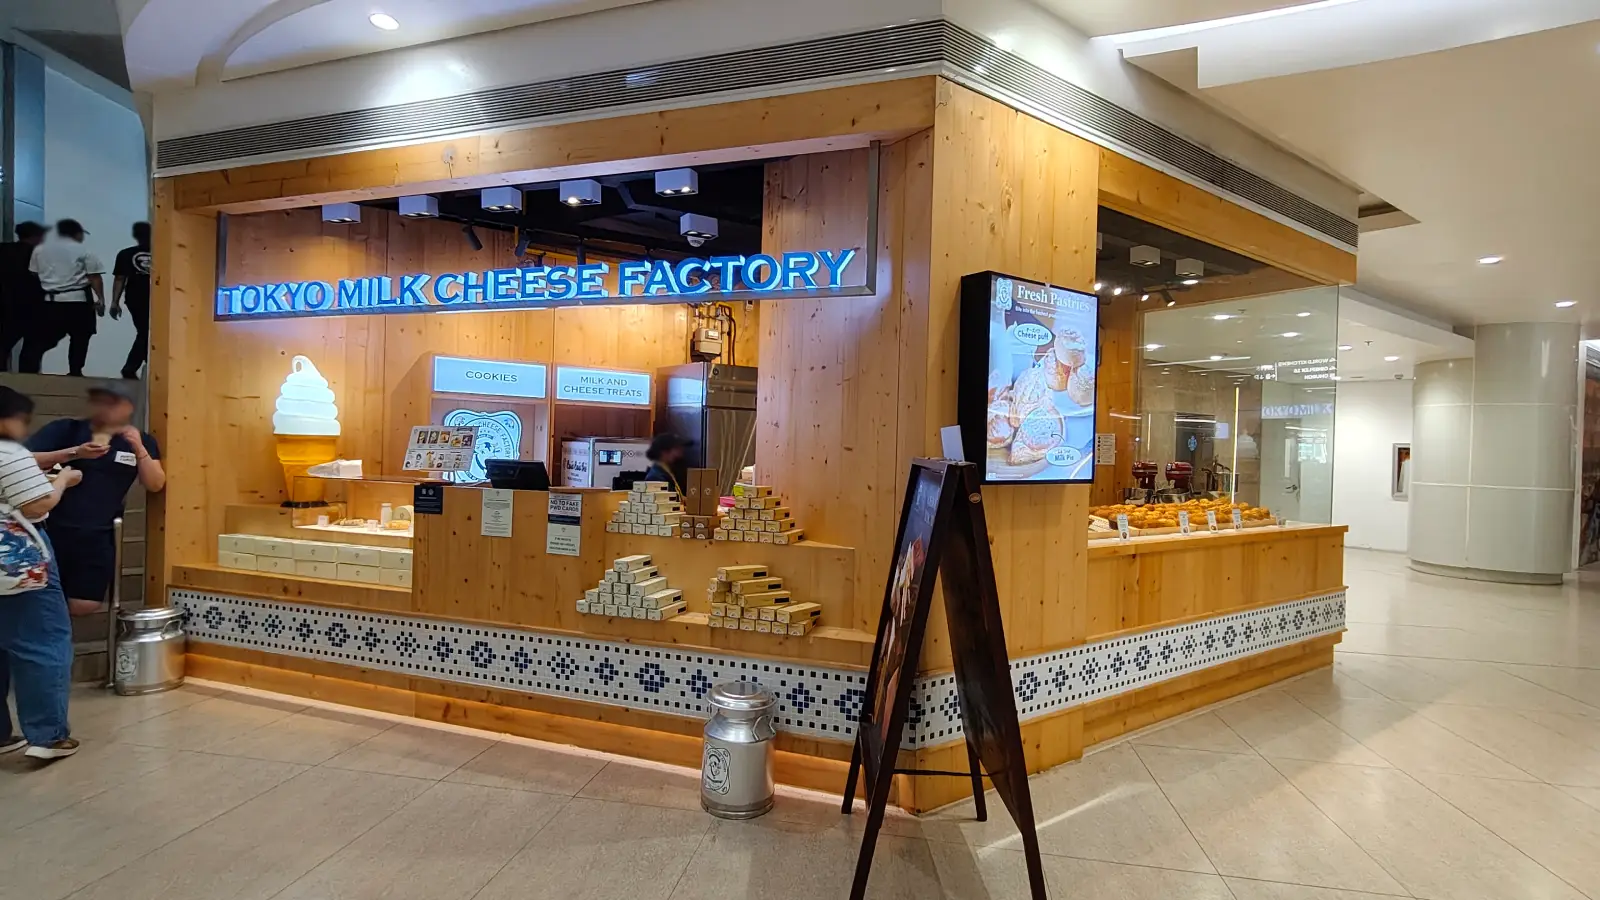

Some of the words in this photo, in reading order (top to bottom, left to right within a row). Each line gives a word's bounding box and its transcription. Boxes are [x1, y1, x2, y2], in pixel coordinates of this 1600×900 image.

[218, 281, 333, 314] TOKYO
[338, 273, 432, 309] MILK
[434, 262, 609, 304] CHEESE
[617, 250, 856, 296] FACTORY
[1016, 285, 1048, 304] Fresh
[1050, 292, 1090, 311] Pastries
[1017, 330, 1037, 339] Cheese
[1037, 333, 1049, 342] puff
[465, 370, 518, 382] COOKIES
[580, 376, 604, 385] MILK
[606, 378, 628, 386] AND
[563, 385, 605, 395] CHEESE
[607, 388, 643, 397] TREATS
[479, 421, 502, 434] CHEESE
[501, 433, 511, 459] FACTORY
